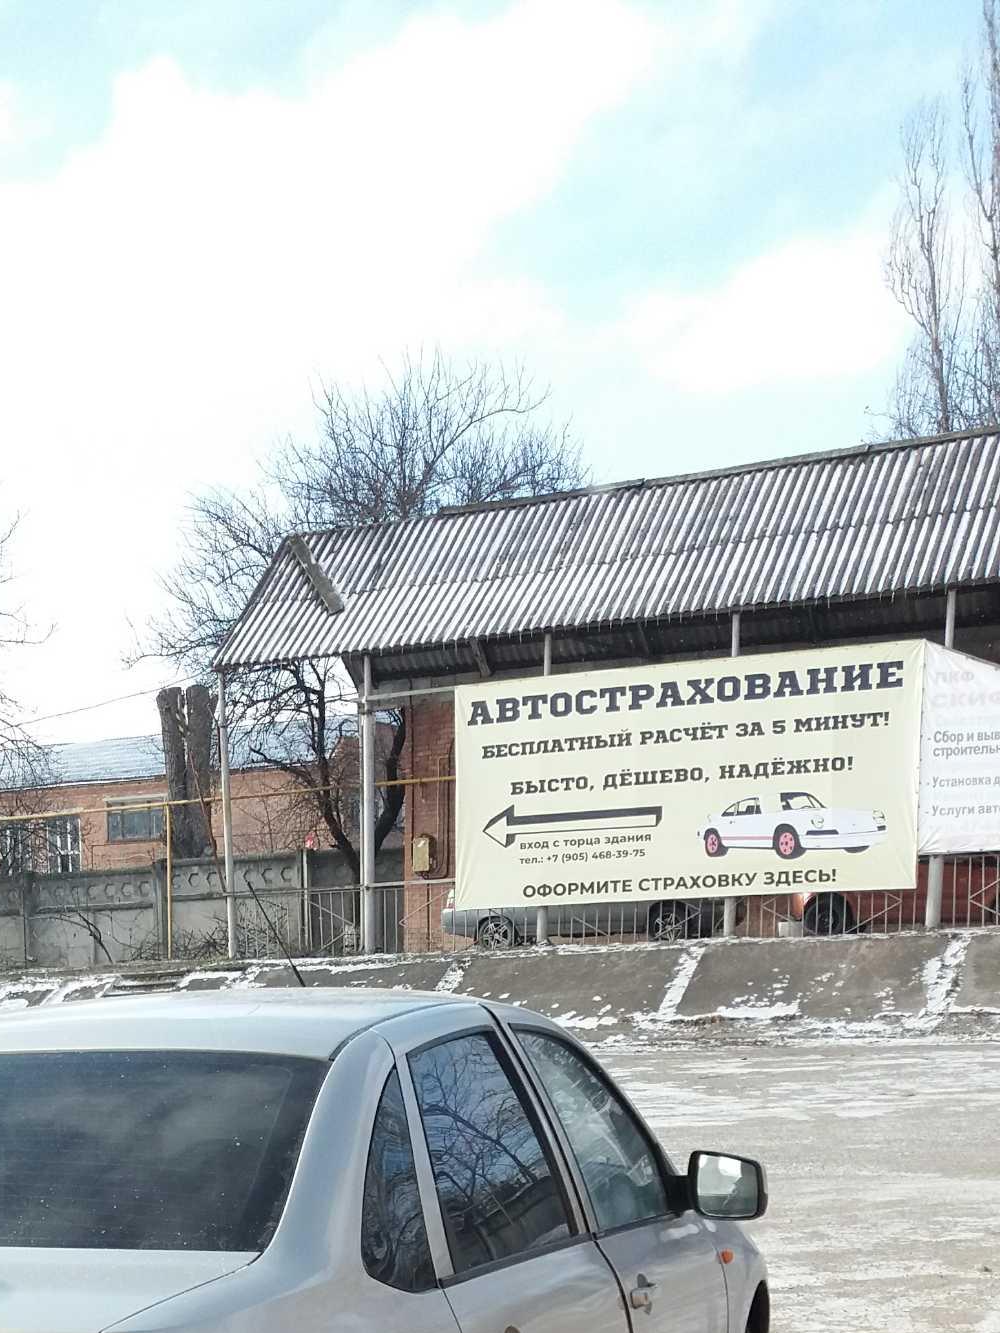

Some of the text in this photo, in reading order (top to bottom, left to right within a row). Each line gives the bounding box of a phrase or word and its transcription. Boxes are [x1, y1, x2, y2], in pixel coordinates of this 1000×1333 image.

[468, 661, 904, 726] АВТОСТРАХОВАНИЕ
[482, 711, 890, 759] БЕСПЛАТНЫЙ РАСЧЁТ ЗА 5 МИНУТ!
[934, 731, 964, 745] Сбор
[966, 732, 974, 742] и
[511, 756, 853, 796] БЫСТО, ДЁШЕВО, НАДЁЖНО!
[932, 776, 992, 788] Установка
[932, 805, 1000, 818] Услуги авт
[520, 833, 652, 850] вход с торца здания
[520, 849, 646, 865] тел.: +7 (905) 468-39-75
[522, 868, 837, 898] ОФОРМИТЕ СТРАХОВКУ ЗДЕСЬ!
